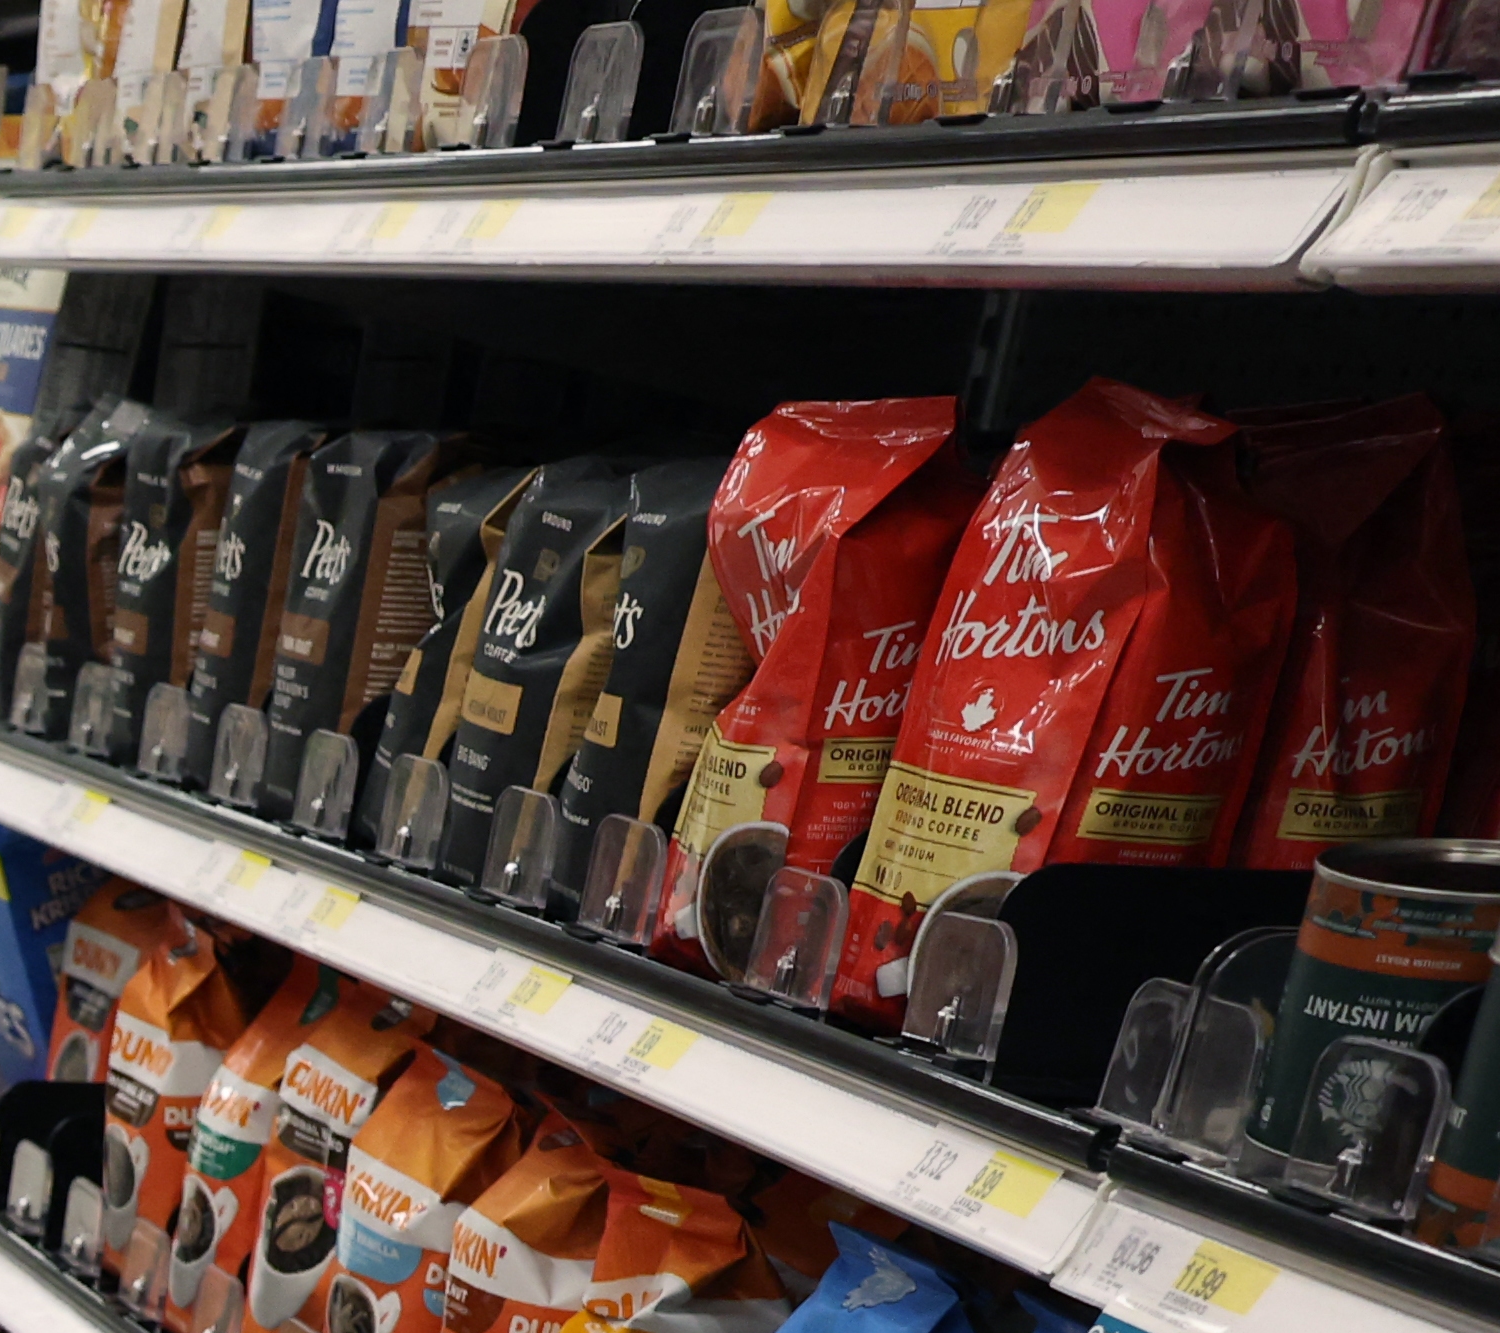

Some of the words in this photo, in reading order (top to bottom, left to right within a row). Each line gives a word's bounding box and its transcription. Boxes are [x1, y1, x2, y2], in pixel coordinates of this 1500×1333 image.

[984, 512, 1068, 588] Tim
[935, 588, 1106, 667] Hortons
[1156, 666, 1230, 720] Tim
[941, 799, 1005, 827] BLEND
[1095, 800, 1175, 822] ORIGINAL
[928, 819, 980, 843] COFFEE
[965, 1164, 1005, 1200] 9.99
[1175, 1260, 1228, 1300] 11.99
